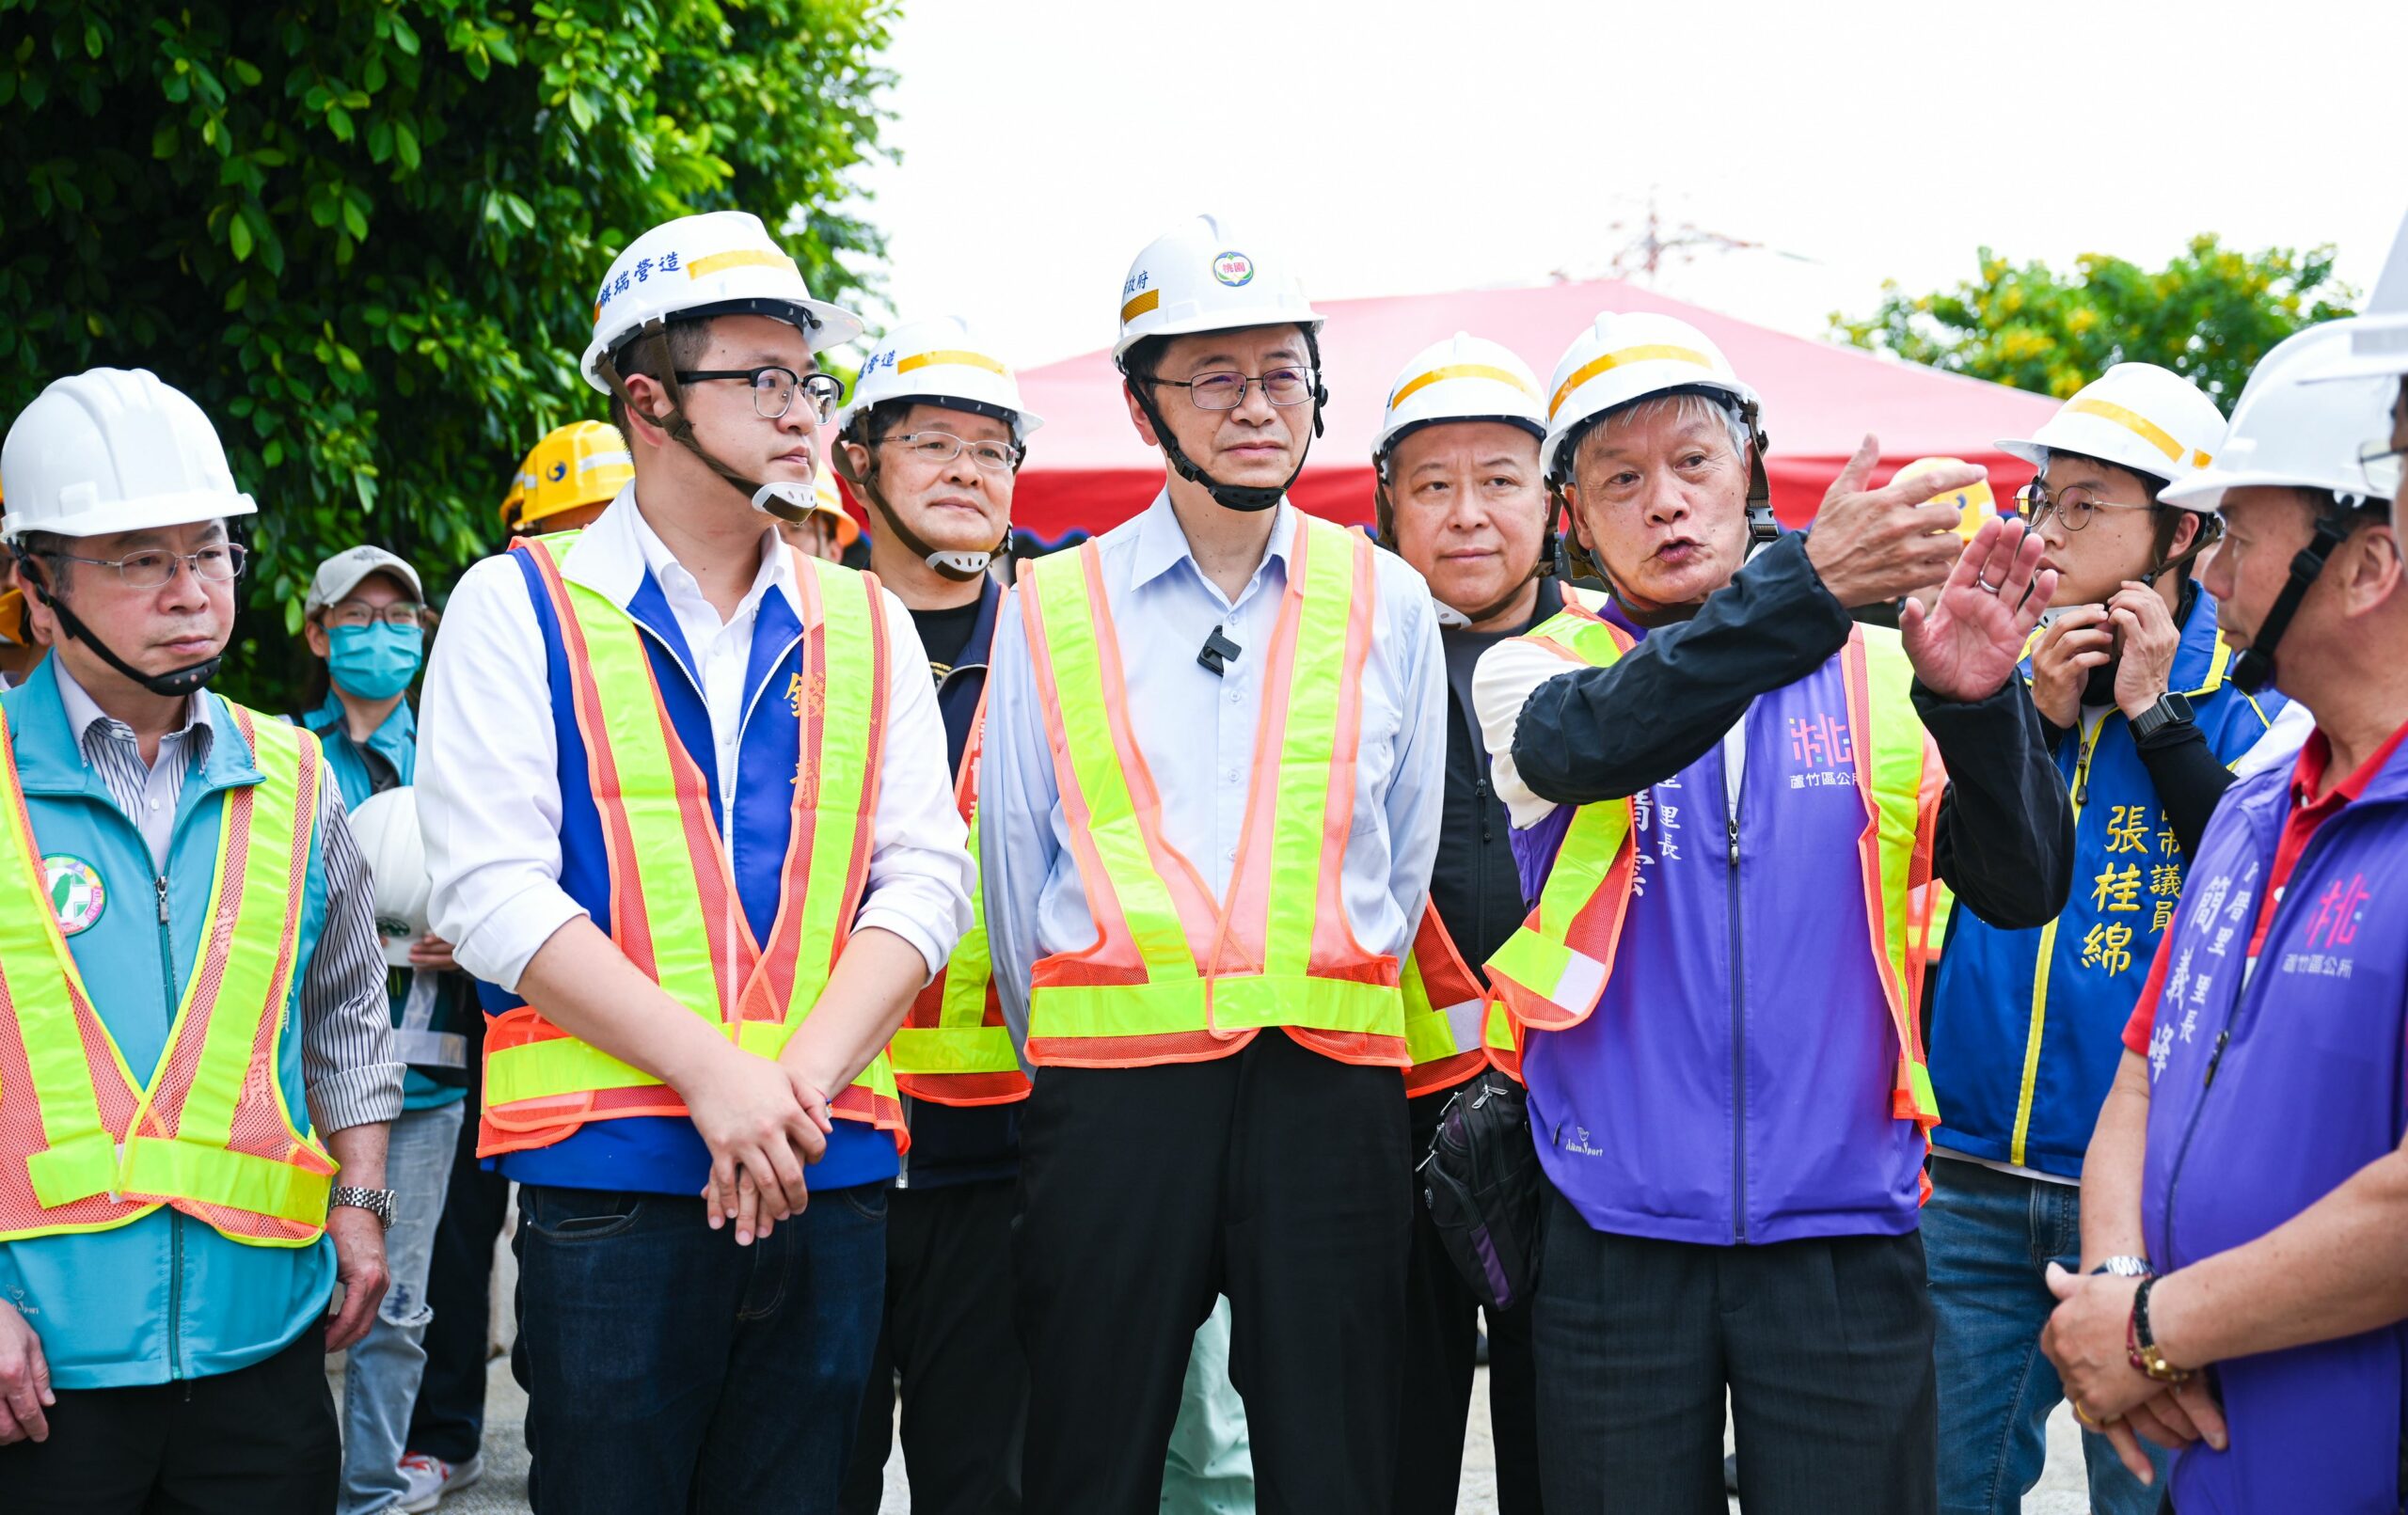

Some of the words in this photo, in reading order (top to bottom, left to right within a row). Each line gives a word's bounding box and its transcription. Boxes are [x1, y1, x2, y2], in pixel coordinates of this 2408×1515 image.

[2081, 805, 2149, 978] 張桂綿
[2148, 809, 2182, 934] 市議員
[2282, 954, 2353, 979] 蘆竹區公所
